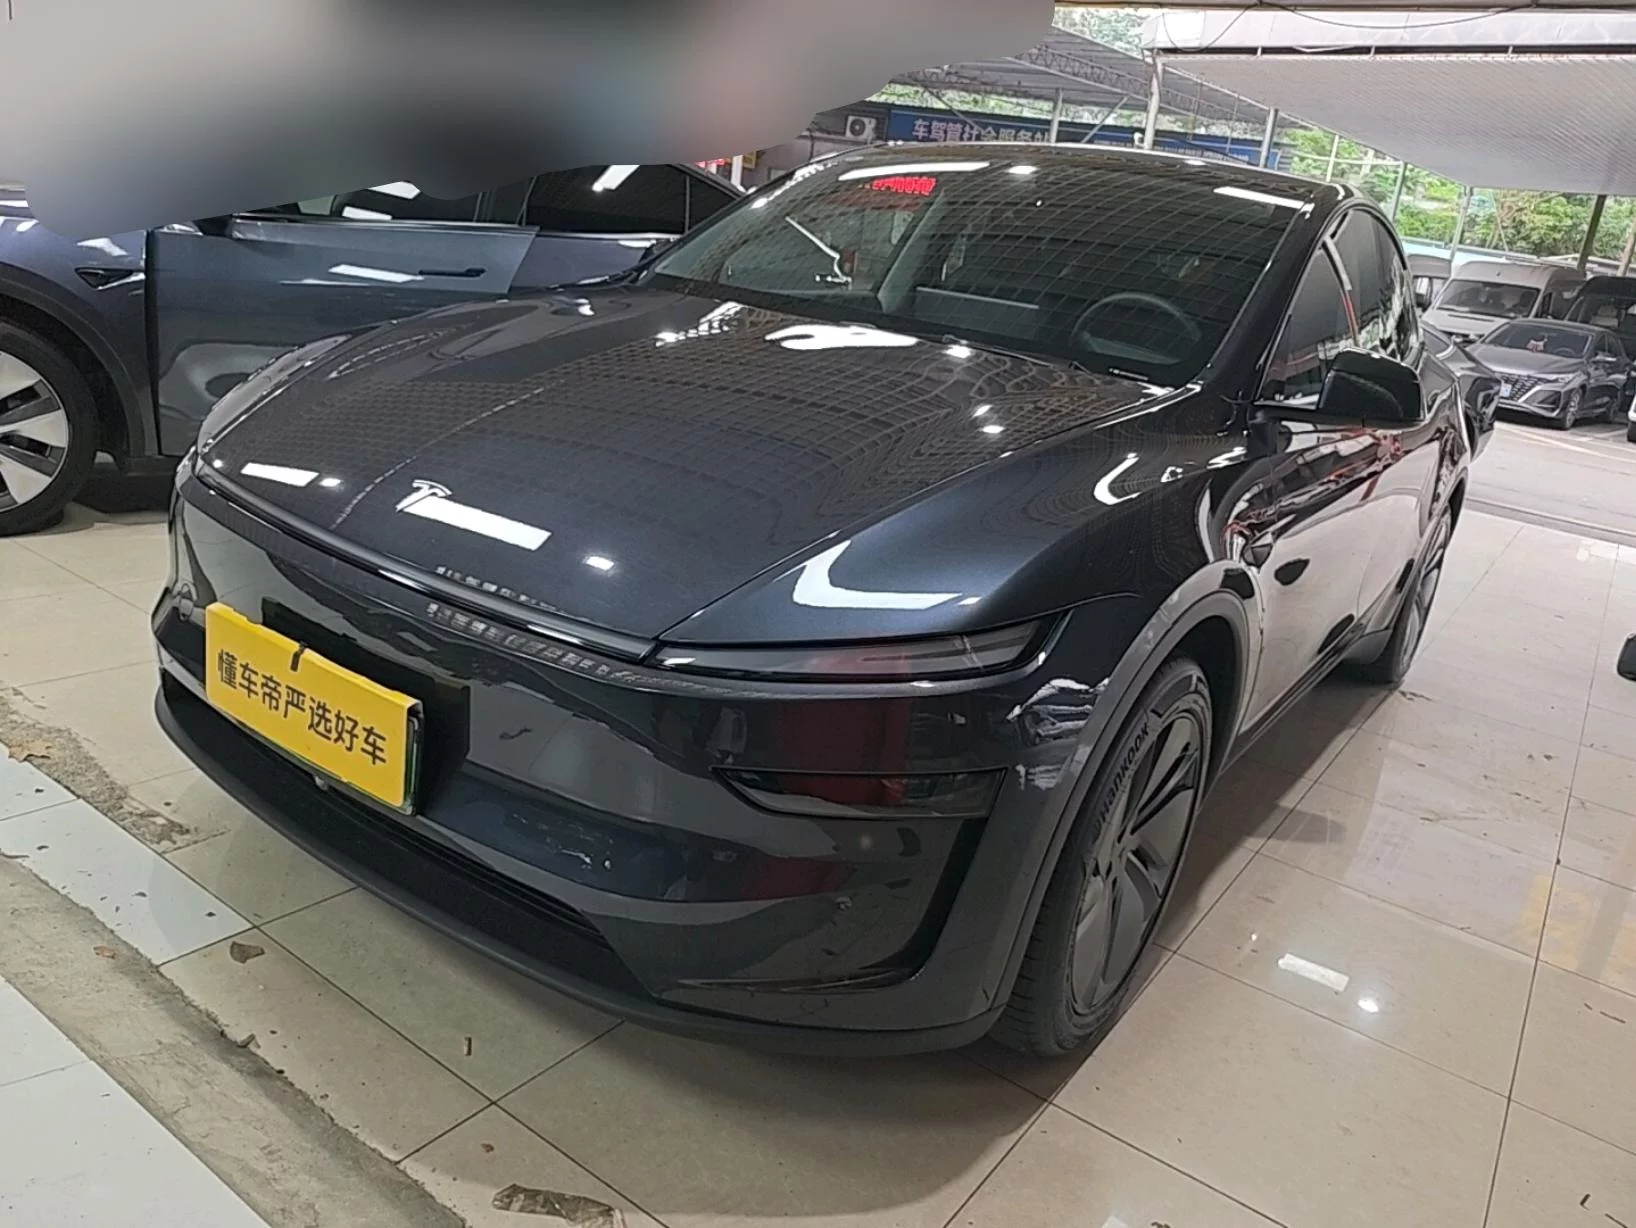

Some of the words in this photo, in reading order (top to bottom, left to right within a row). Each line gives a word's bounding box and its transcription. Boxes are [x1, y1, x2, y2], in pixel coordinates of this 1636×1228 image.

[217, 648, 387, 765] 懂车帝严选好车
